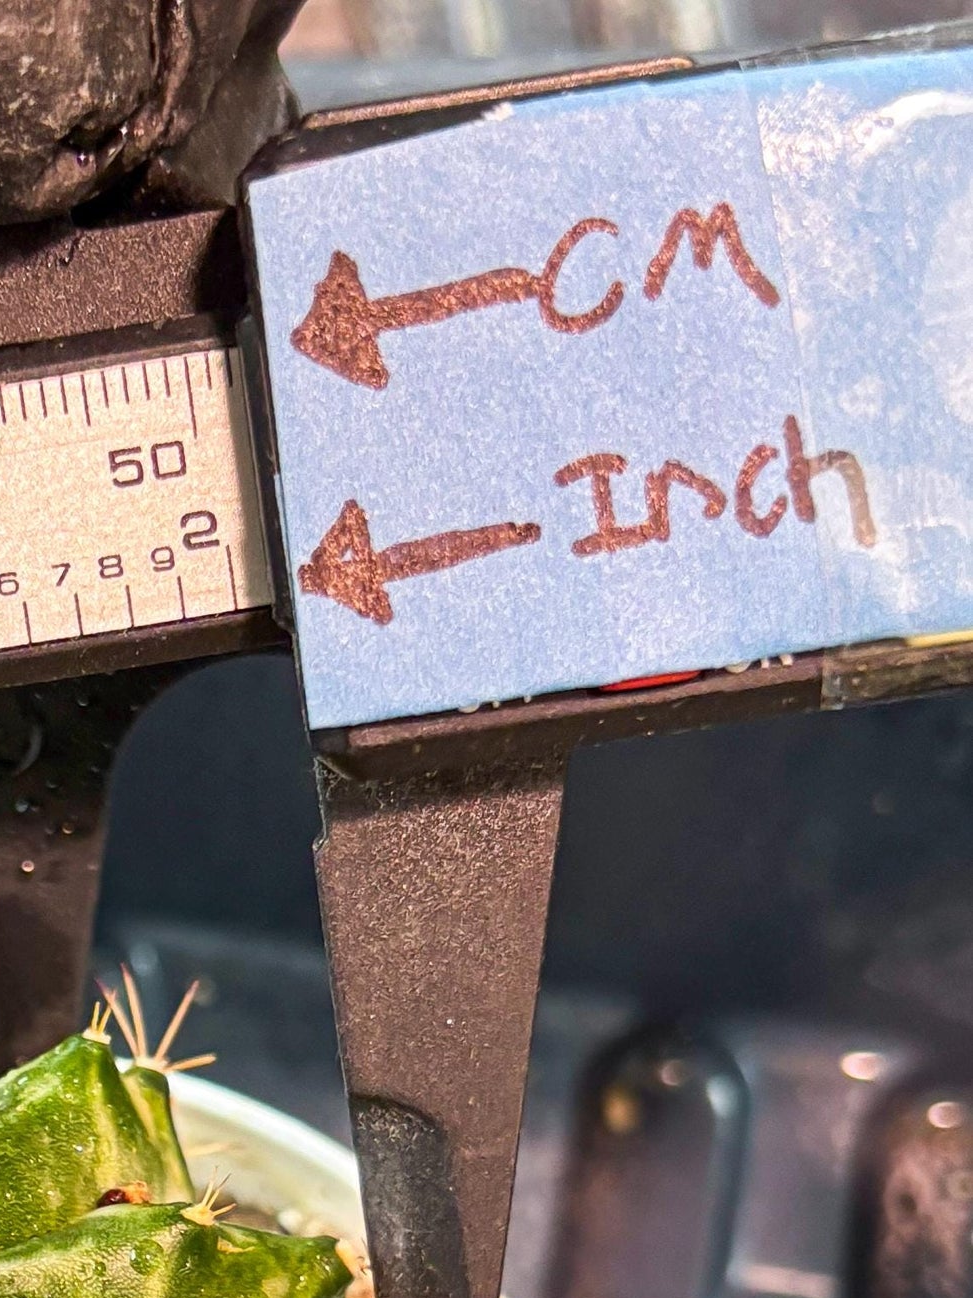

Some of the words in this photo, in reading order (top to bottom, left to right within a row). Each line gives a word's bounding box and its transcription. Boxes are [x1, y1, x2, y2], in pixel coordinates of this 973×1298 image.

[109, 440, 188, 488] 50
[553, 415, 877, 555] Inch
[50, 562, 72, 588] 7
[97, 553, 125, 579] 8
[149, 545, 176, 572] 9
[179, 509, 221, 552] 2
